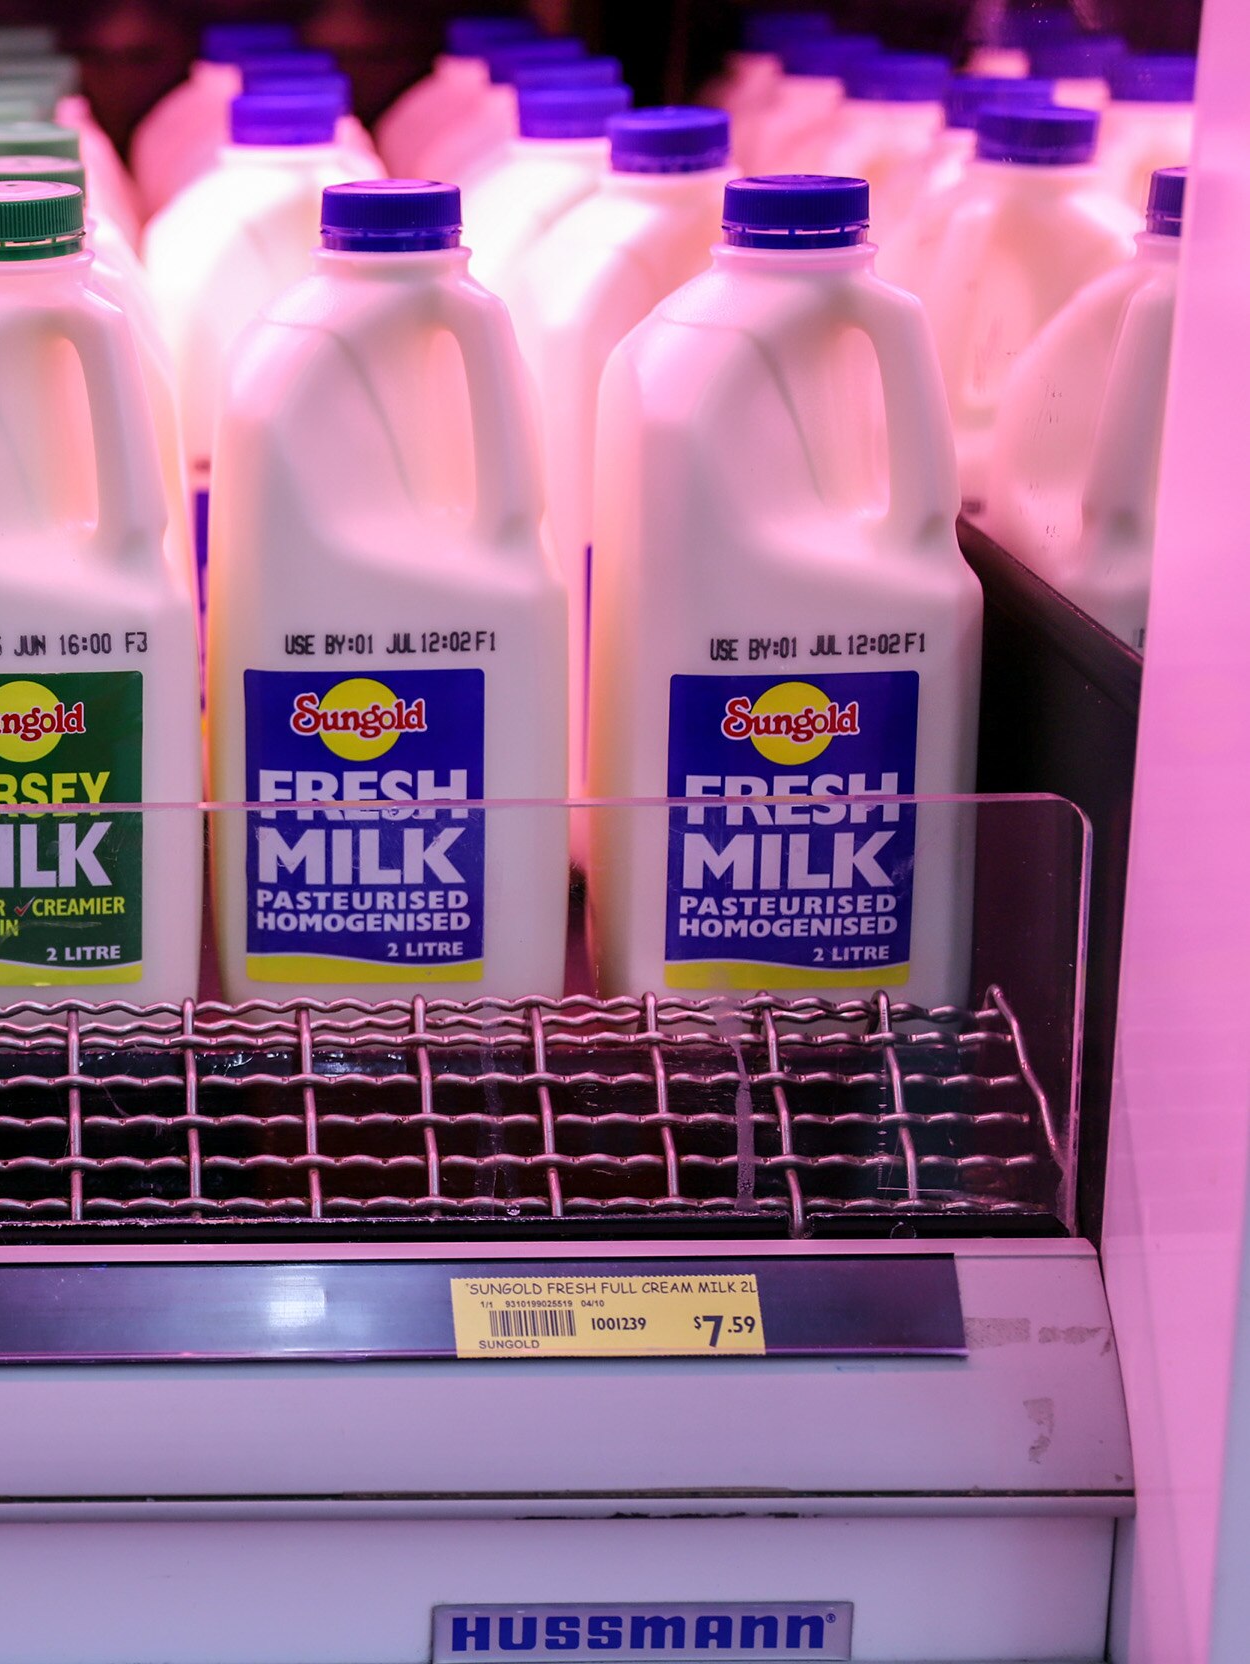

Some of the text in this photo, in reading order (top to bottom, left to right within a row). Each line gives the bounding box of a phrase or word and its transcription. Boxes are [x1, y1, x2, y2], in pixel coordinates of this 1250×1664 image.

[14, 635, 46, 656] JUN
[60, 633, 111, 655] 16:00
[125, 632, 147, 653] F3
[285, 635, 315, 655] USE
[325, 634, 374, 654] BY:01
[710, 639, 738, 661] USE
[749, 637, 797, 660] BY:01
[290, 692, 427, 739] Sungold
[721, 696, 860, 743] Sungold
[259, 769, 468, 820] FRESH
[686, 772, 900, 826] FRESH
[257, 827, 466, 885] MILK
[683, 831, 896, 890] MILK
[32, 897, 125, 916] CREAMIER
[256, 889, 468, 911] PASTEURISED
[679, 894, 896, 916] PASTEURISED
[256, 911, 471, 932] HOMOGENISED
[679, 916, 898, 937] HOMOGENISED
[47, 946, 121, 961] 2 LITRE
[388, 942, 463, 957] 2 LITRE
[813, 946, 889, 961] 2 LITRE
[548, 1283, 596, 1294] FRESH
[601, 1282, 637, 1294] FULL
[642, 1282, 692, 1293] CREAM
[698, 1282, 736, 1293] MILK
[741, 1282, 757, 1293] 2L
[591, 1318, 646, 1330] 1001239
[479, 1340, 539, 1349] SUNGOLD
